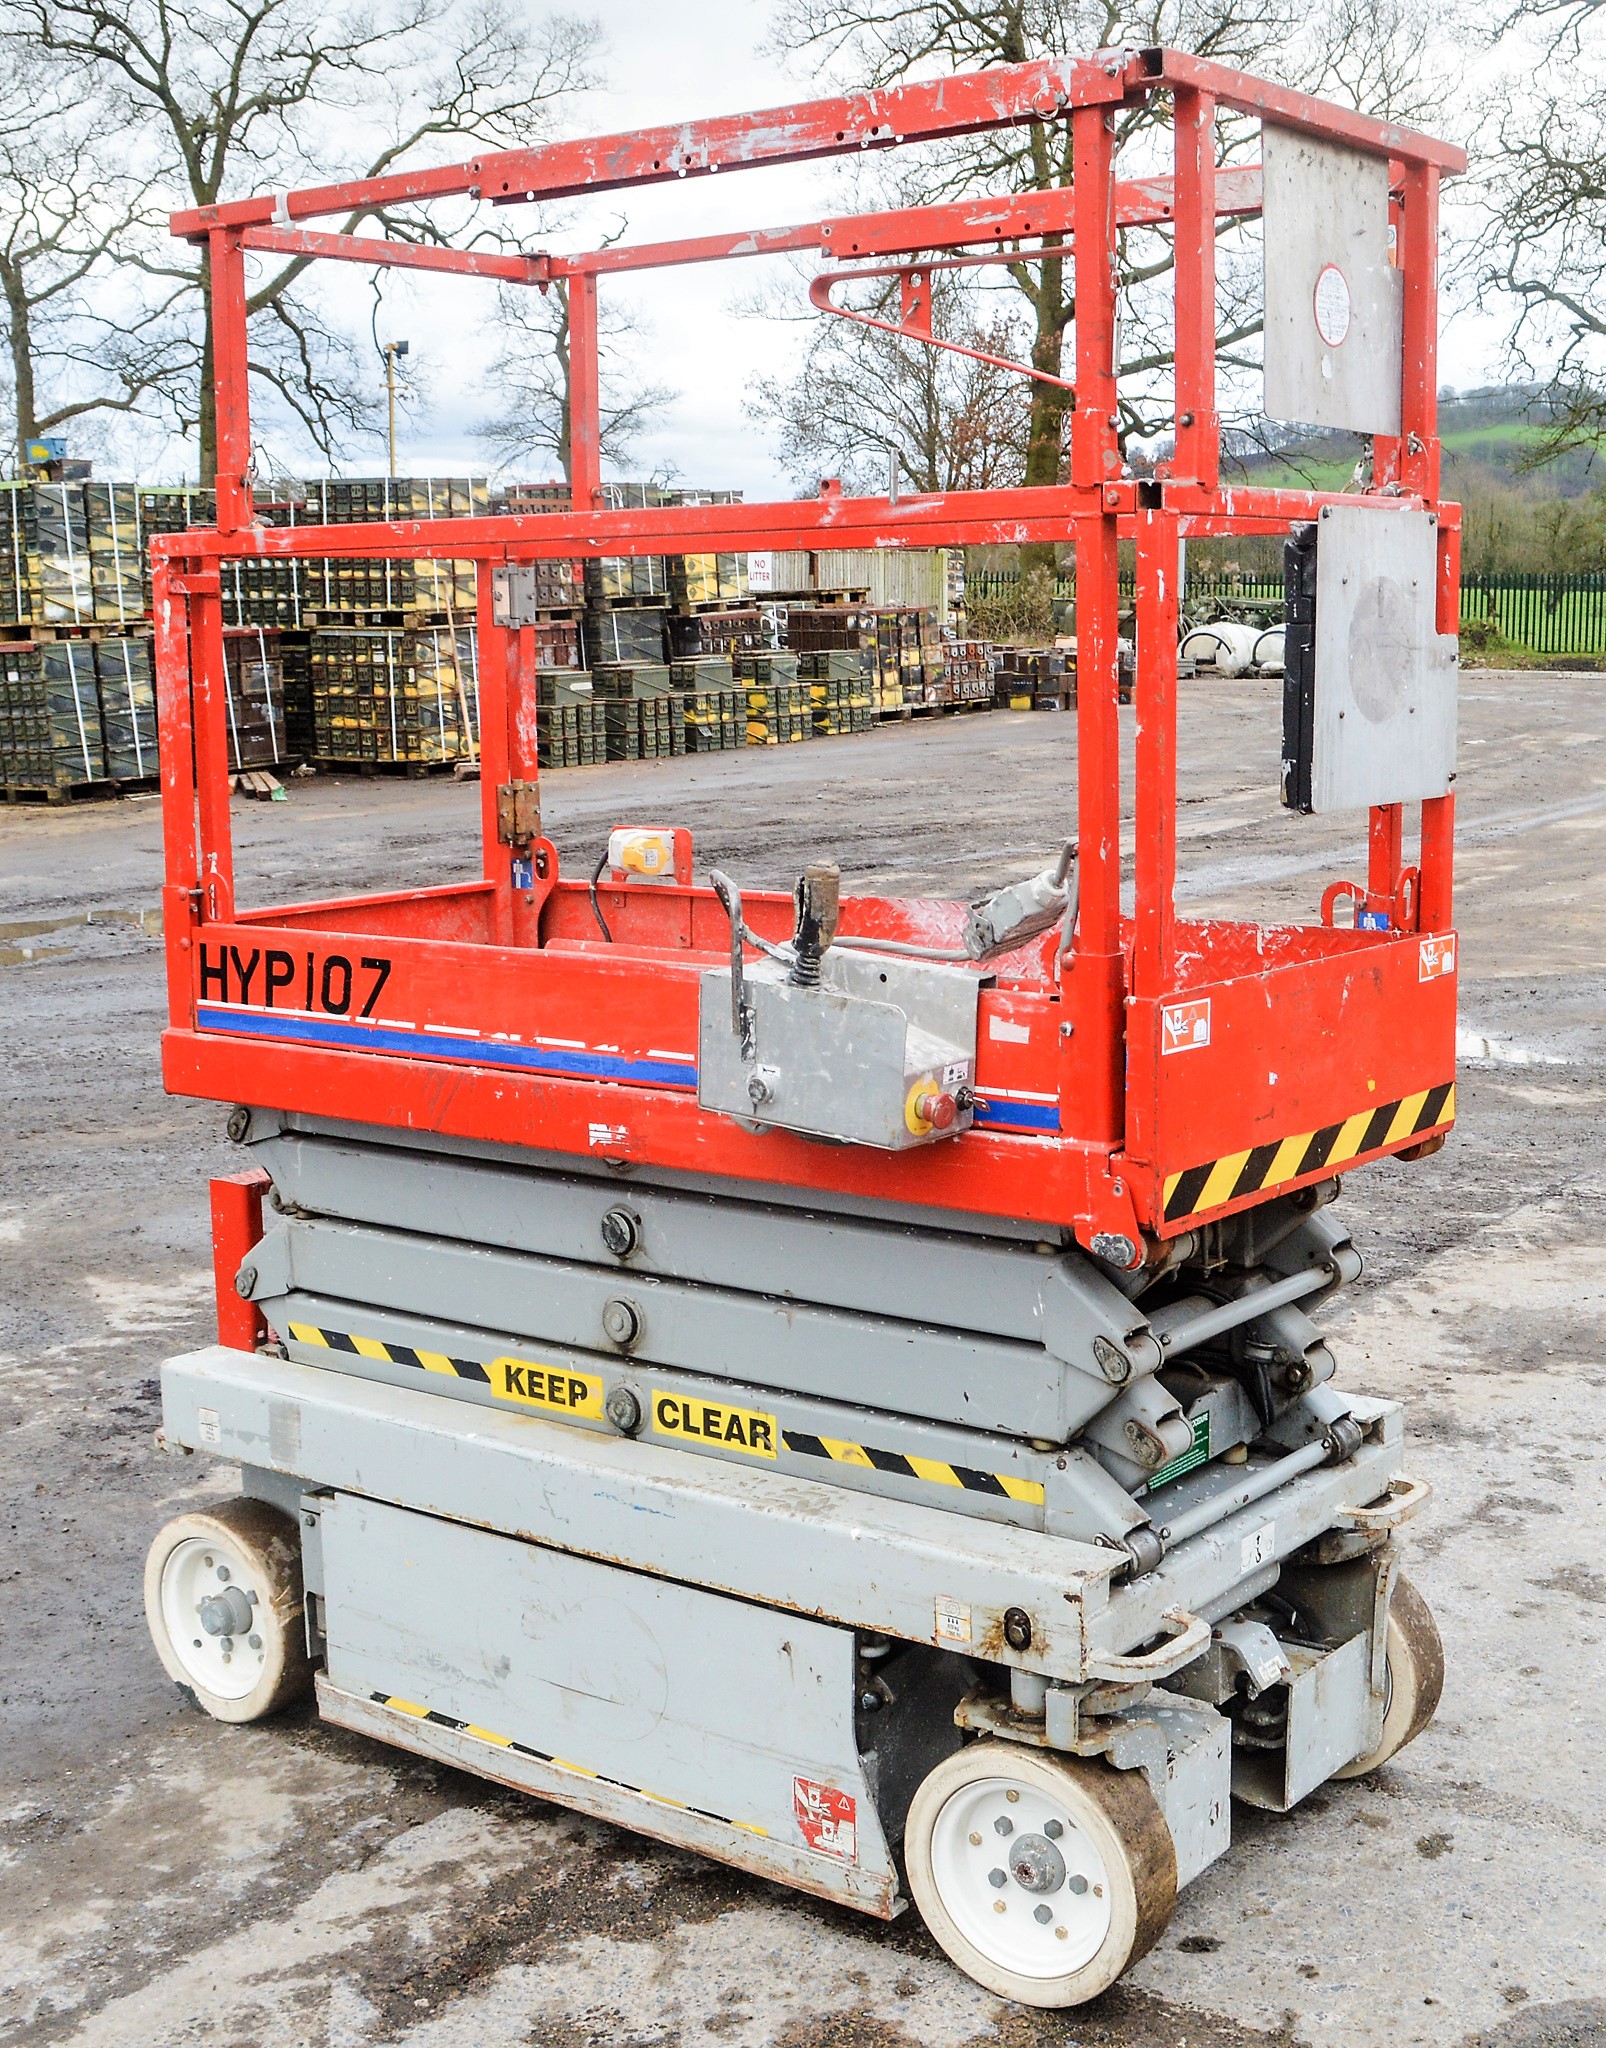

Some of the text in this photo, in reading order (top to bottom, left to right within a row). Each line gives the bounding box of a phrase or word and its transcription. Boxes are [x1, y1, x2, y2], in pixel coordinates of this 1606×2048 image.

[749, 571, 771, 581] LITTER
[754, 559, 766, 569] NO
[199, 942, 392, 1018] HYP107
[504, 1364, 773, 1452] KEEP CLEAR
